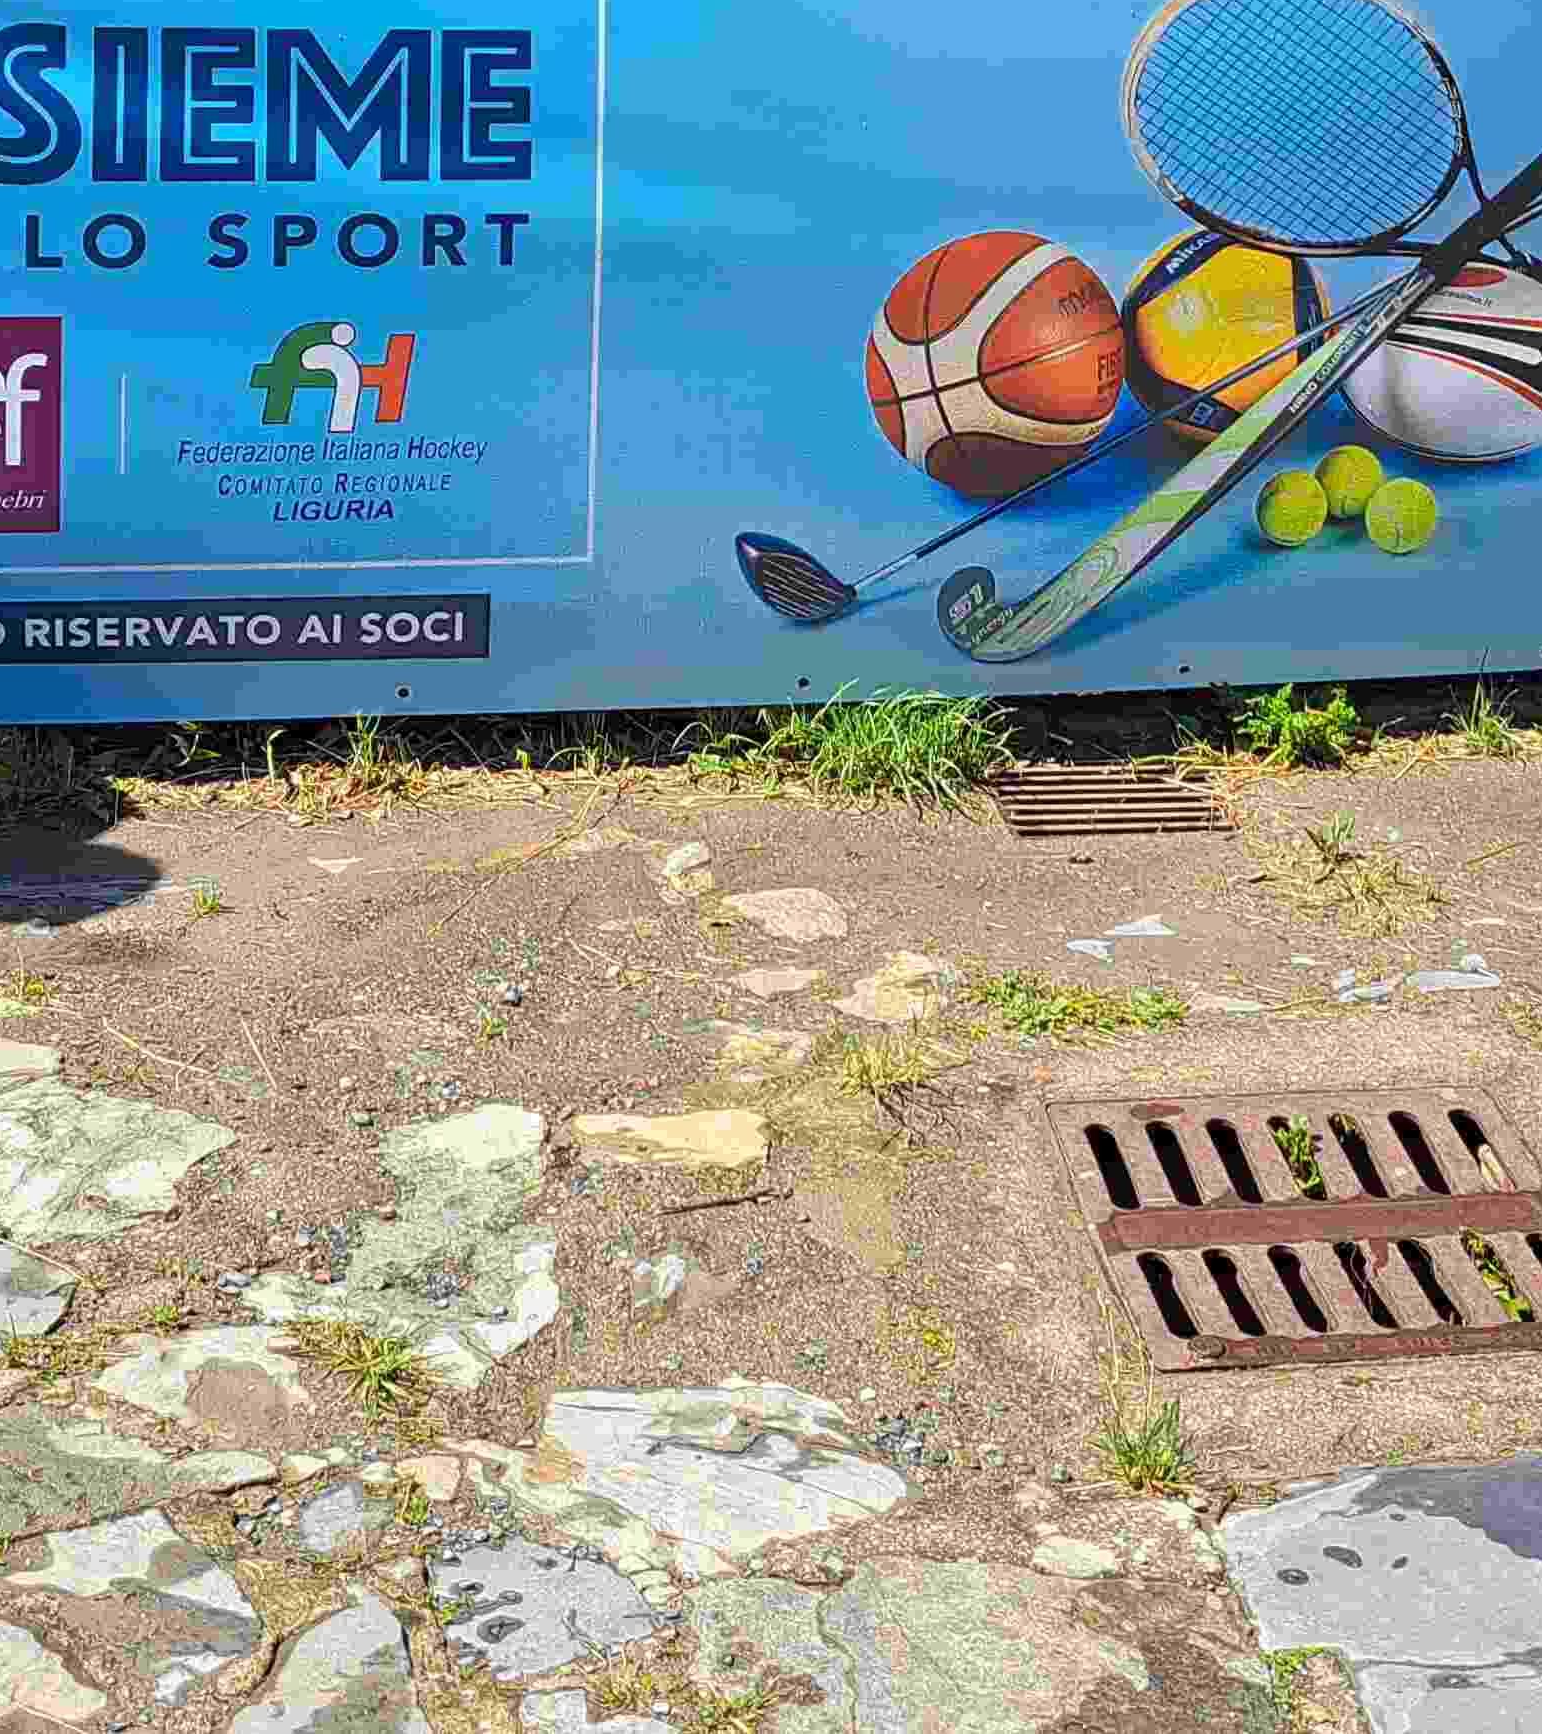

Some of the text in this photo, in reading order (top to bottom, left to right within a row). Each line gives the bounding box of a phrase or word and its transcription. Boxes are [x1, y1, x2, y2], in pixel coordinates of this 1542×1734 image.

[25, 212, 147, 269] LO
[205, 212, 531, 269] SPORT
[177, 435, 488, 465] Federazione Italiana Hockey
[218, 472, 452, 495] COMITATO REGIONALE
[273, 498, 395, 522] LIGURIA
[24, 614, 282, 648] RISERVATO
[296, 614, 343, 645] AI
[360, 611, 464, 645] SOCI
